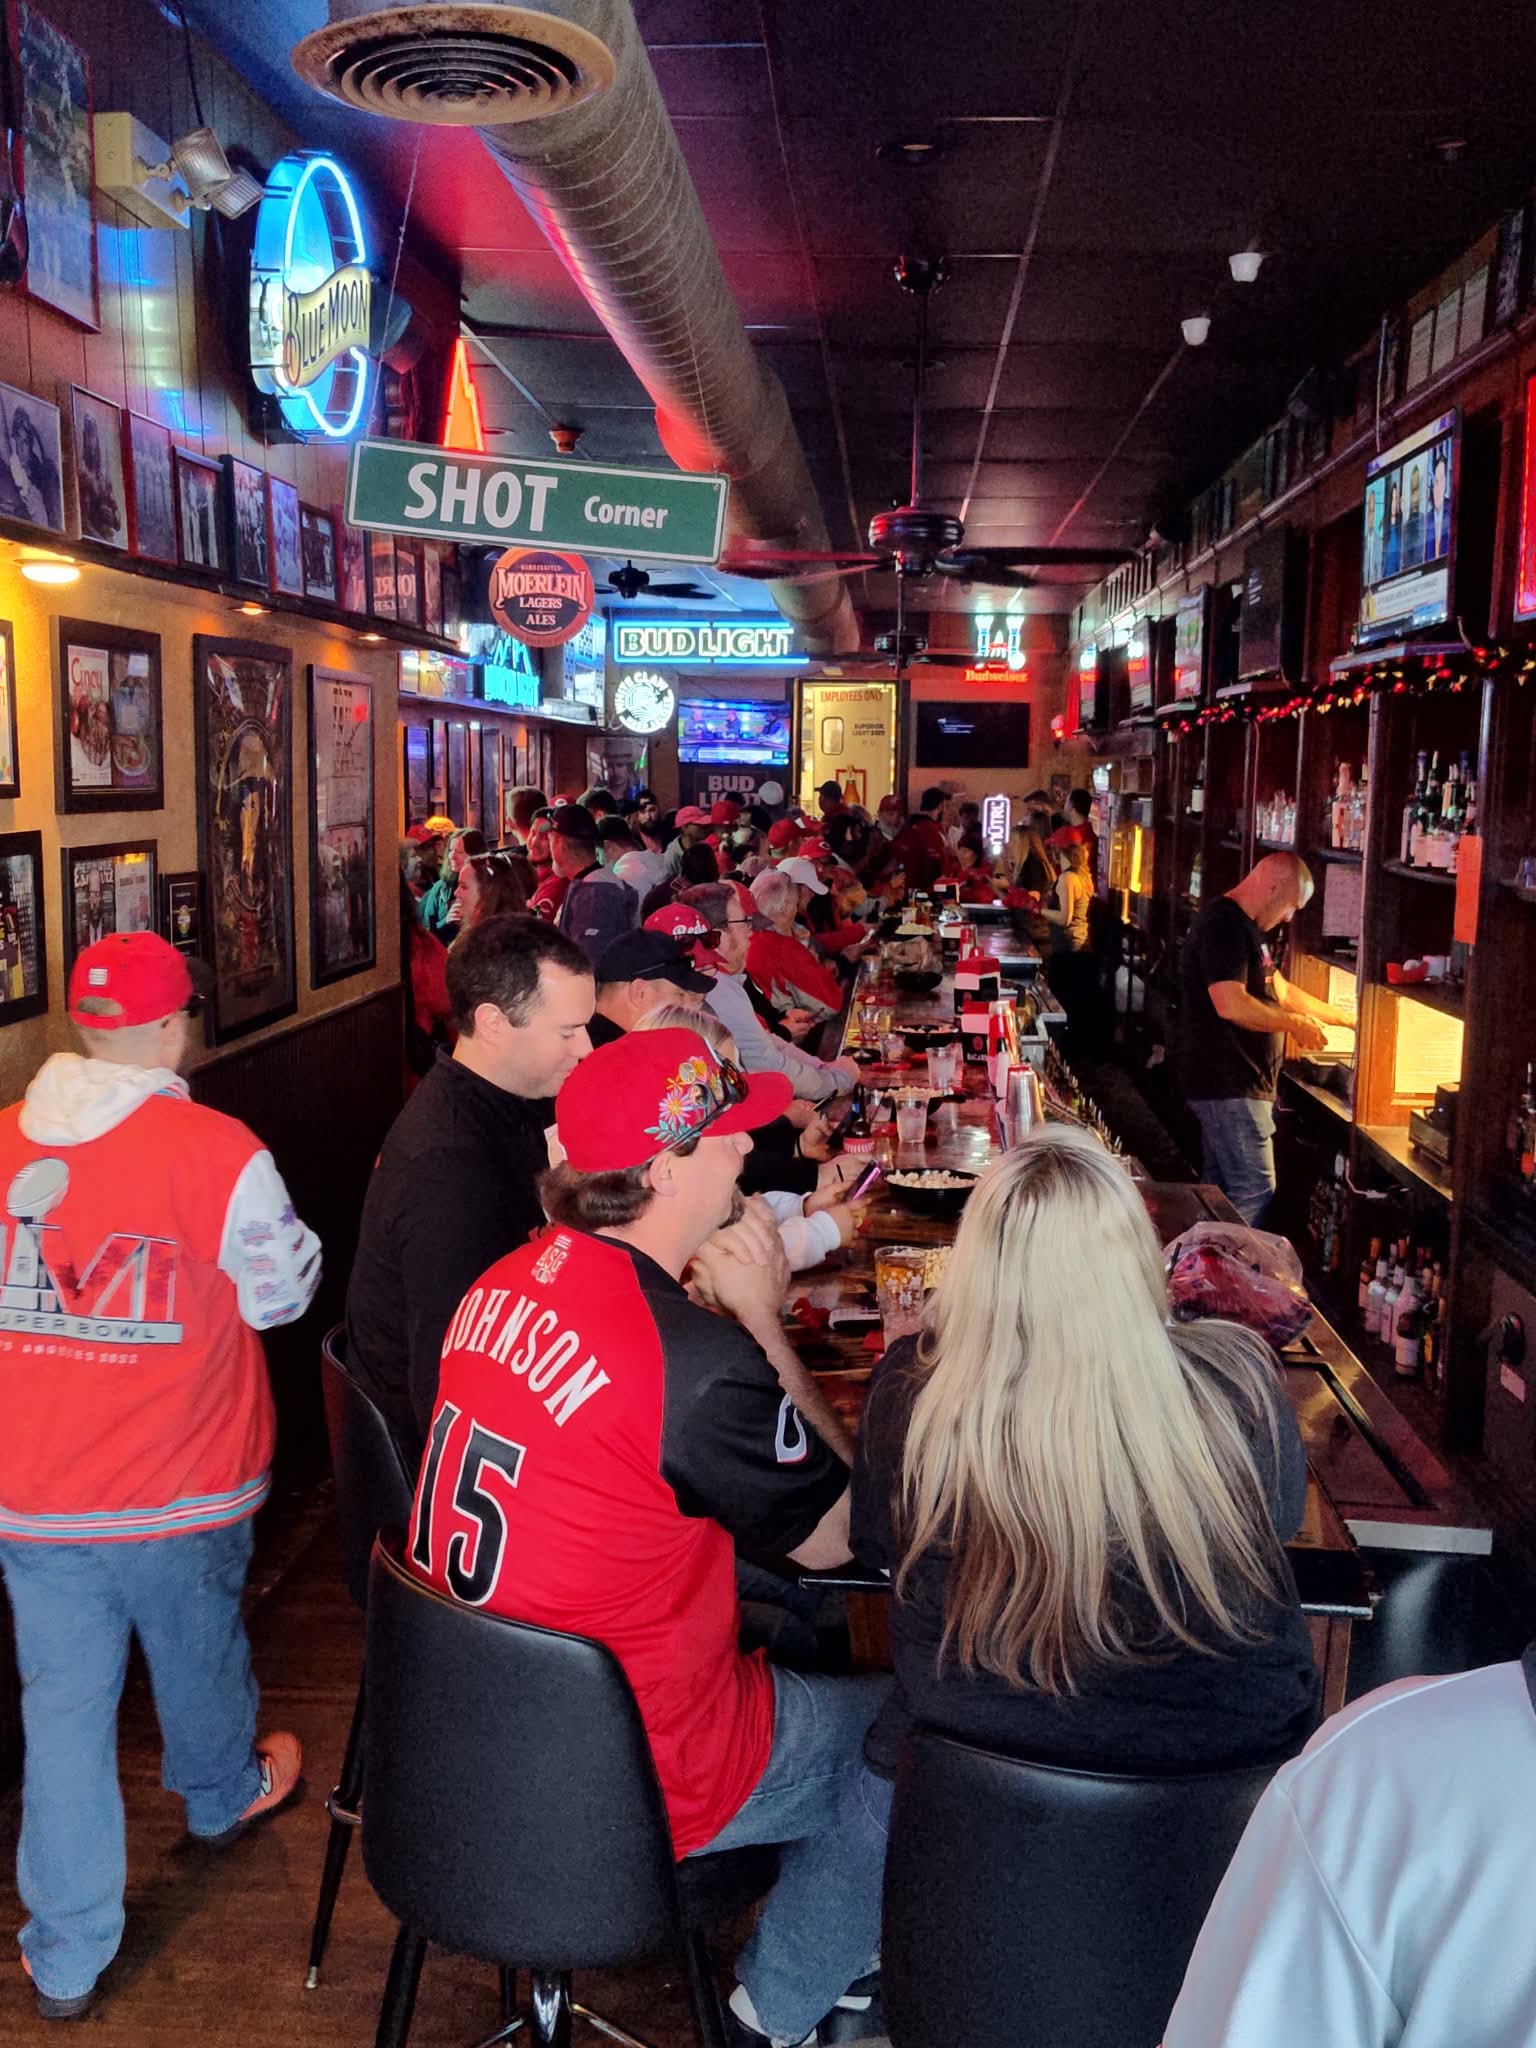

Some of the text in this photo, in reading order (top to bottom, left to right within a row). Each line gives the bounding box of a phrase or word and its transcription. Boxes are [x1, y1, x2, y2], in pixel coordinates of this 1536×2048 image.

[285, 279, 368, 387] BLUE MOON
[403, 462, 669, 533] SHOT Corner
[495, 567, 588, 611] MOERLEIN
[520, 597, 562, 609] LAGERS
[526, 613, 556, 625] ALES
[620, 627, 794, 657] BUD LIGHT
[965, 669, 1028, 683] Budweiser
[820, 689, 884, 702] EMPLOYEES ONLY
[708, 775, 755, 792] BUD
[441, 1287, 611, 1428] JOHNSON
[412, 1400, 527, 1607] 15
